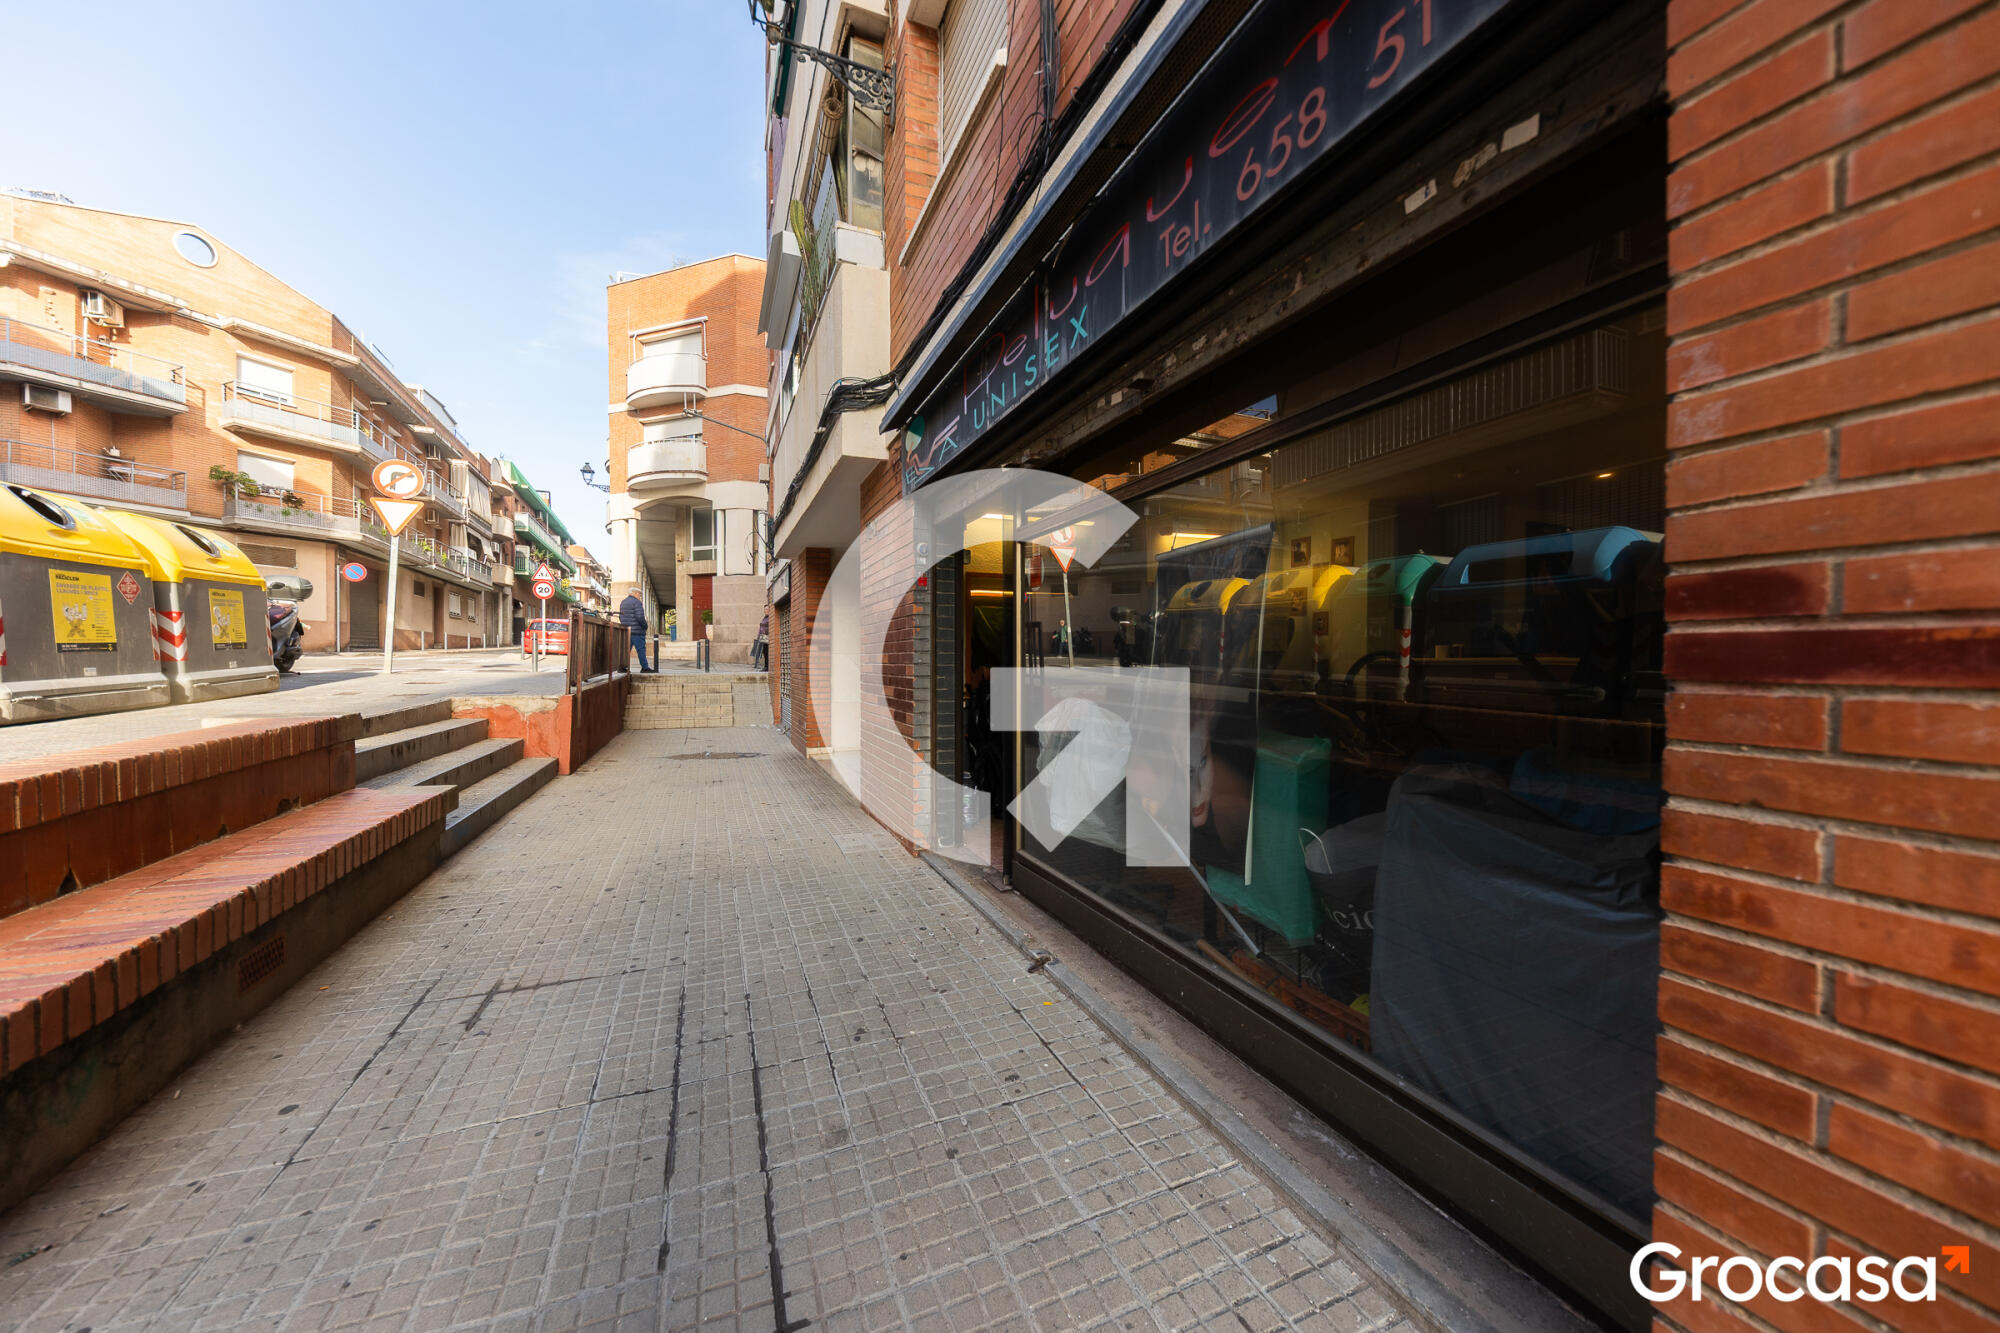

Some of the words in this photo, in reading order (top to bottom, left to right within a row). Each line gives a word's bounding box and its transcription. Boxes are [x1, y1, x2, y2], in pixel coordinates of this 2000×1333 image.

[1159, 200, 1213, 268] Tel.
[1235, 86, 1328, 201] 658
[1367, 0, 1432, 89] 51
[973, 304, 1088, 430] UNISEX
[537, 586, 550, 594] 20
